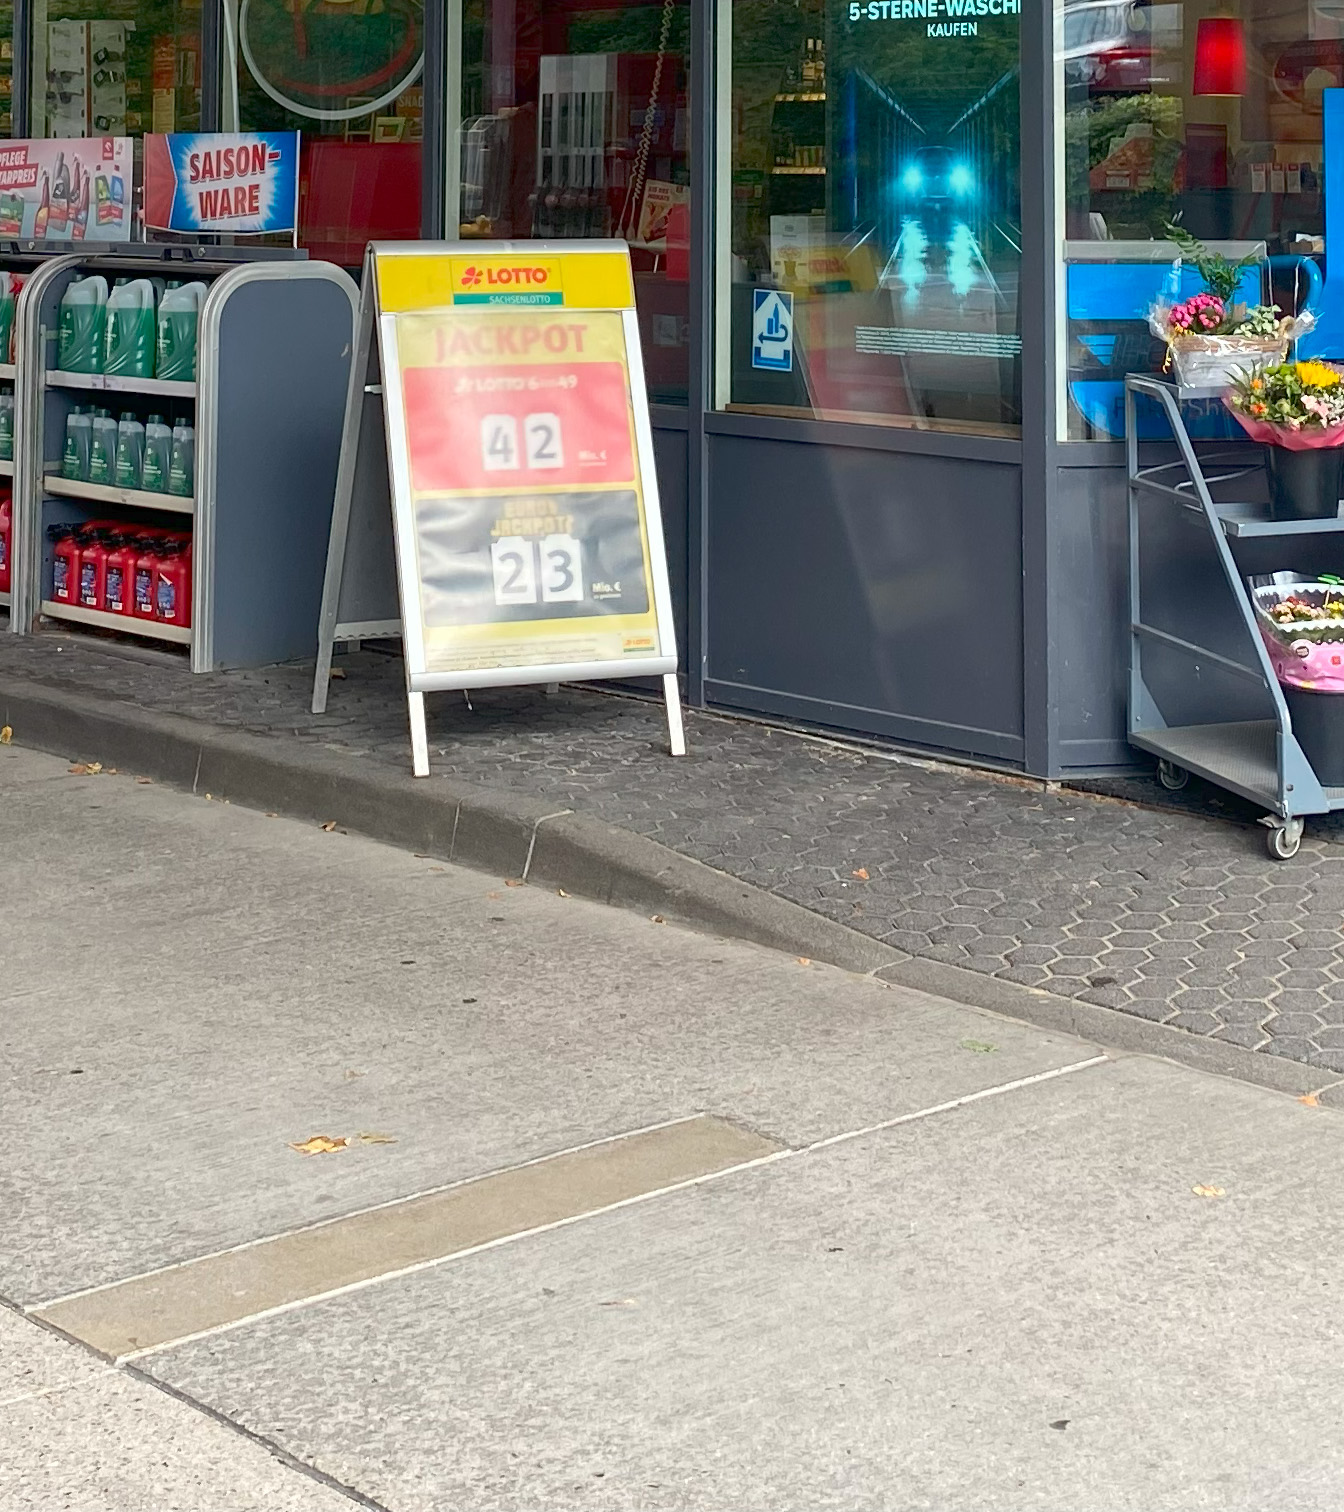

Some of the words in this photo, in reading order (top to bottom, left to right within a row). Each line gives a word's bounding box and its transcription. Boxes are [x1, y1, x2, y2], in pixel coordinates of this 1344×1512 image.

[927, 22, 978, 37] KAUFEN
[189, 143, 282, 184] SAISON-
[199, 184, 260, 222] WARE
[487, 267, 548, 284] LOTTO
[488, 294, 551, 304] SACHSENLOTTO
[436, 323, 588, 363] JACKPOT
[499, 549, 574, 594] 23
[592, 582, 613, 593] Mio.
